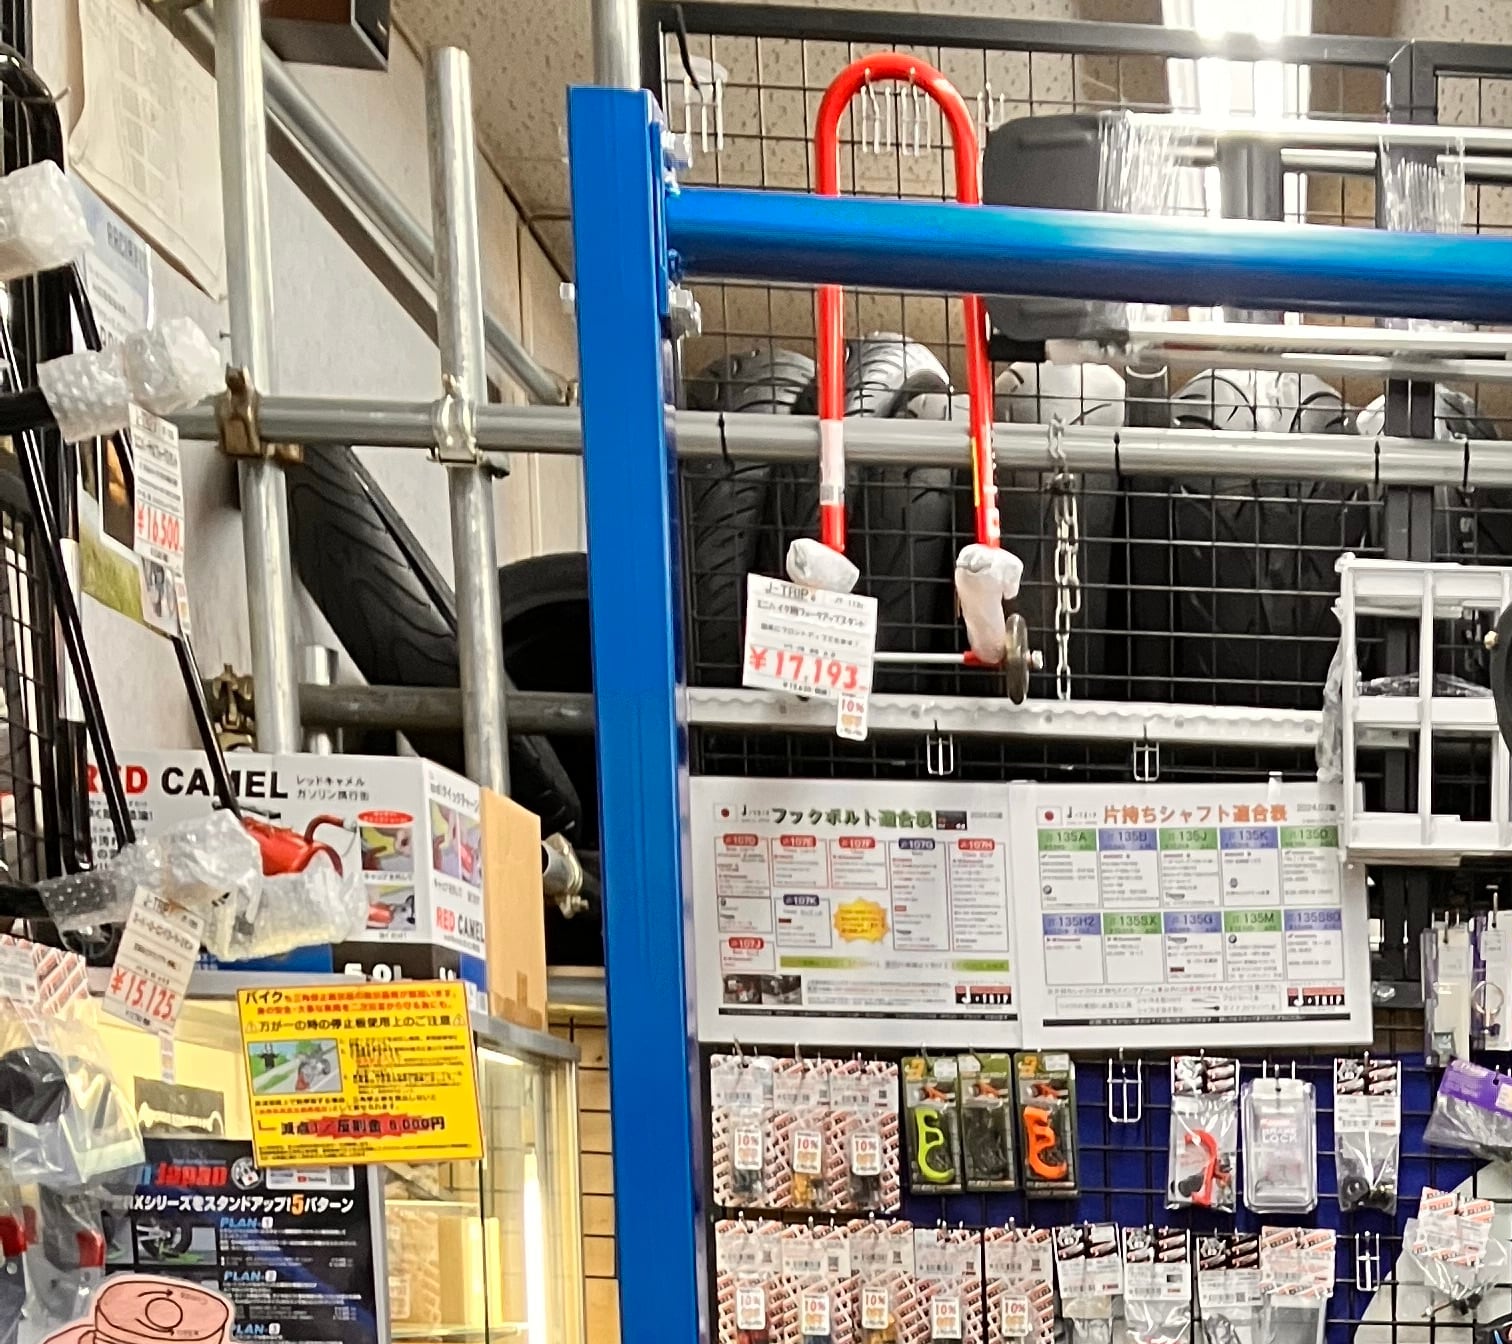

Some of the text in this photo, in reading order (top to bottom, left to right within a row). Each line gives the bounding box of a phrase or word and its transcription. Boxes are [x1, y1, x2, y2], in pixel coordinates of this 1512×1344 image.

[85, 764, 148, 794] RD
[1103, 804, 1288, 824] 片持ちシャフト適合表
[435, 906, 456, 931] RED
